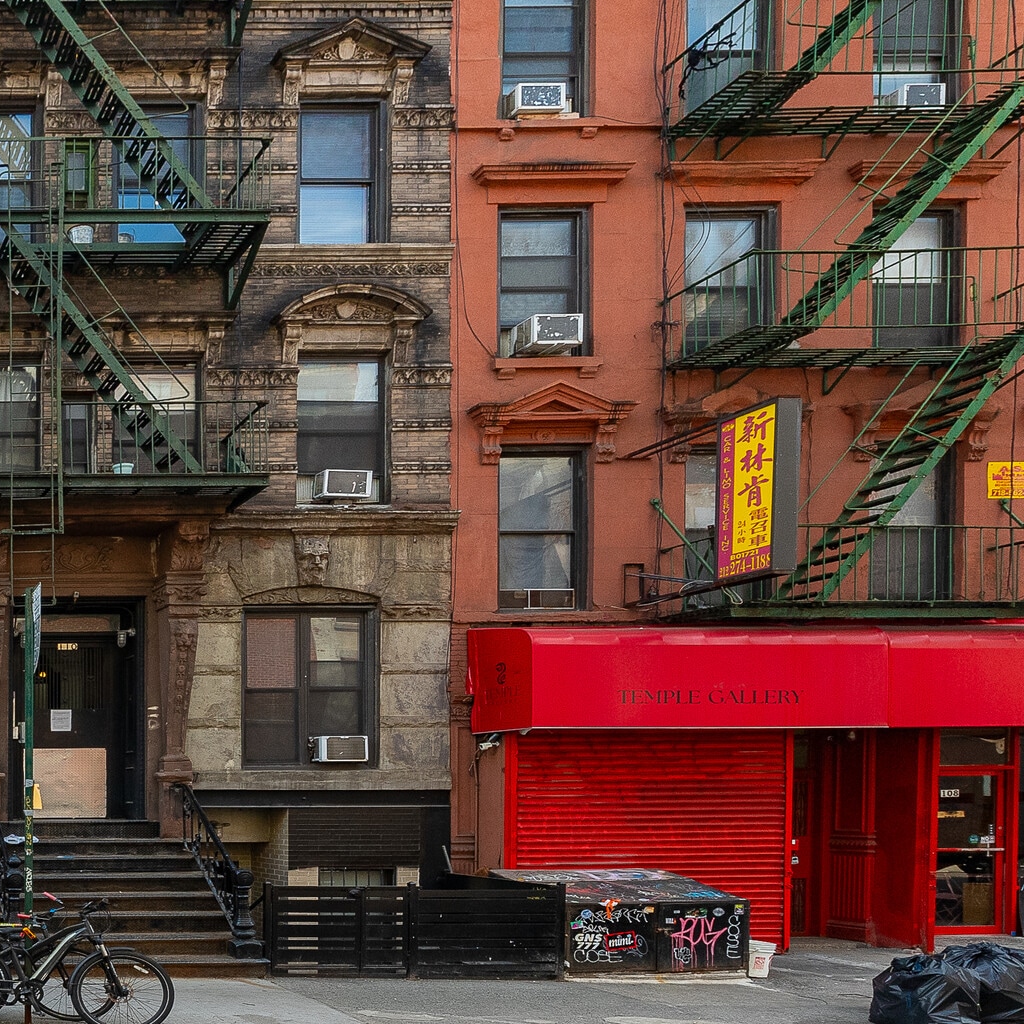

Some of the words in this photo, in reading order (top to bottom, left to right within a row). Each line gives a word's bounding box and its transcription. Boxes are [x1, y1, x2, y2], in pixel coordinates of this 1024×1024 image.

[723, 435, 732, 453] CAR
[617, 689, 701, 705] TEMPLE
[708, 689, 804, 705] GALLERY
[575, 933, 603, 942] GNS
[576, 942, 600, 950] 777
